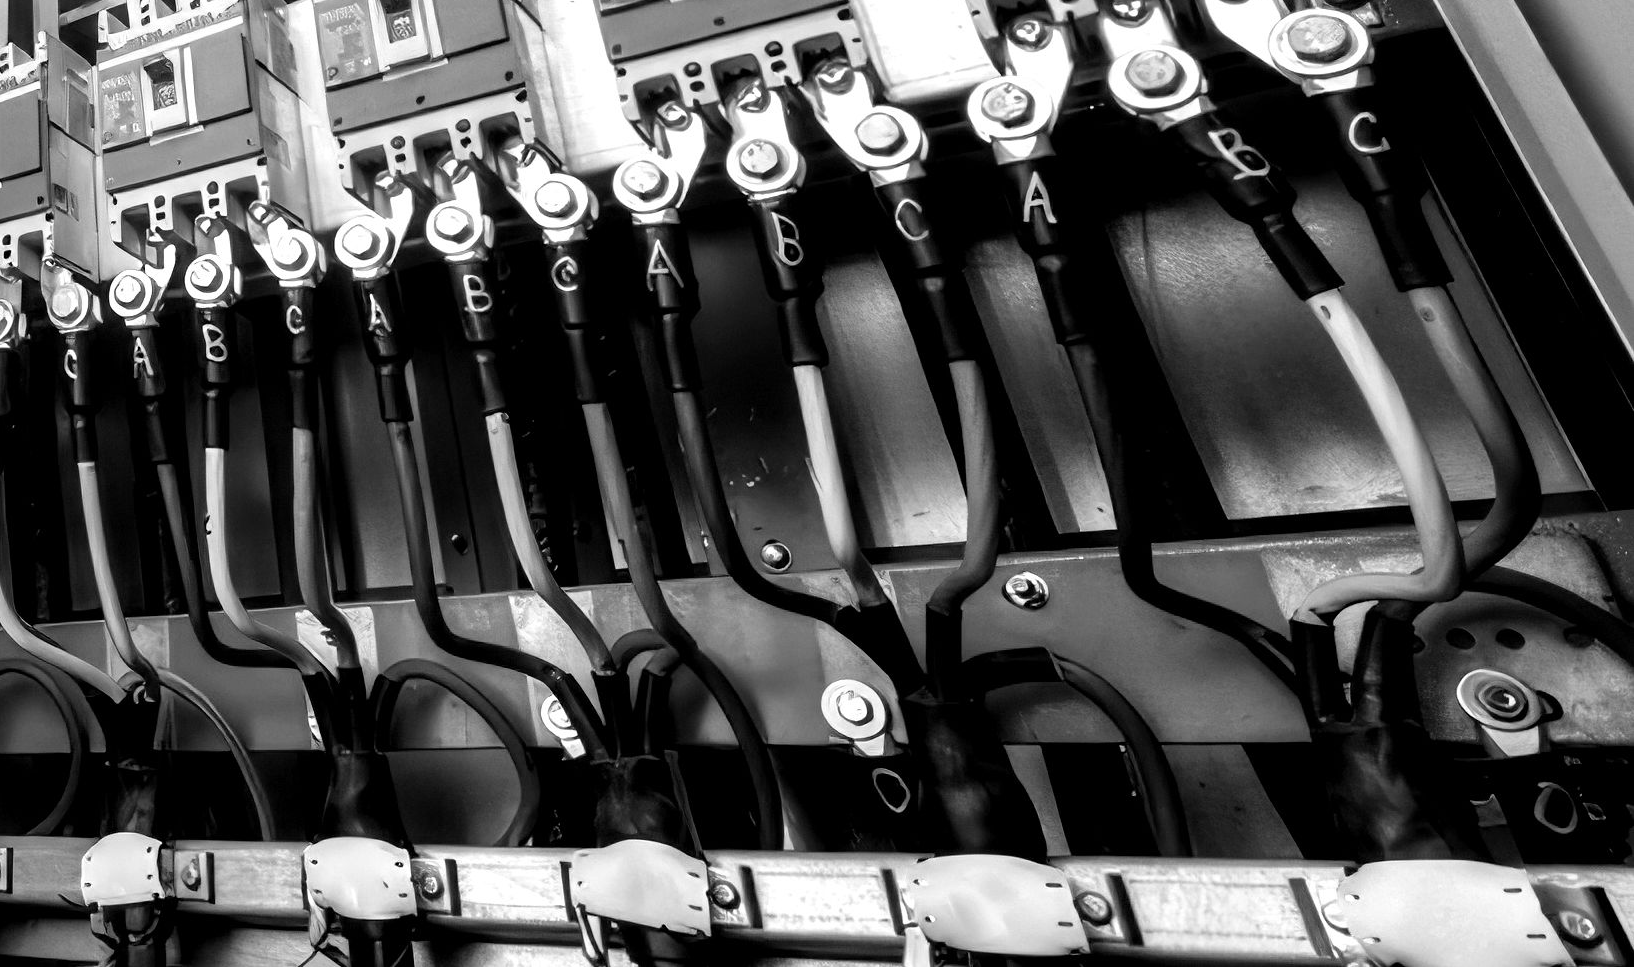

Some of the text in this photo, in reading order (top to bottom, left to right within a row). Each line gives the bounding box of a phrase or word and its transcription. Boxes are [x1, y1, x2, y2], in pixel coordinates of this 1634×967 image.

[1207, 127, 1271, 181] B
[1347, 110, 1391, 155] C
[1022, 170, 1058, 223] A
[771, 211, 804, 267] B
[894, 198, 930, 242] C
[550, 255, 579, 292] C
[645, 238, 685, 292] A
[367, 293, 393, 334] A
[462, 274, 493, 313] B
[285, 304, 306, 335] C
[133, 336, 155, 379] A
[202, 323, 229, 363] B
